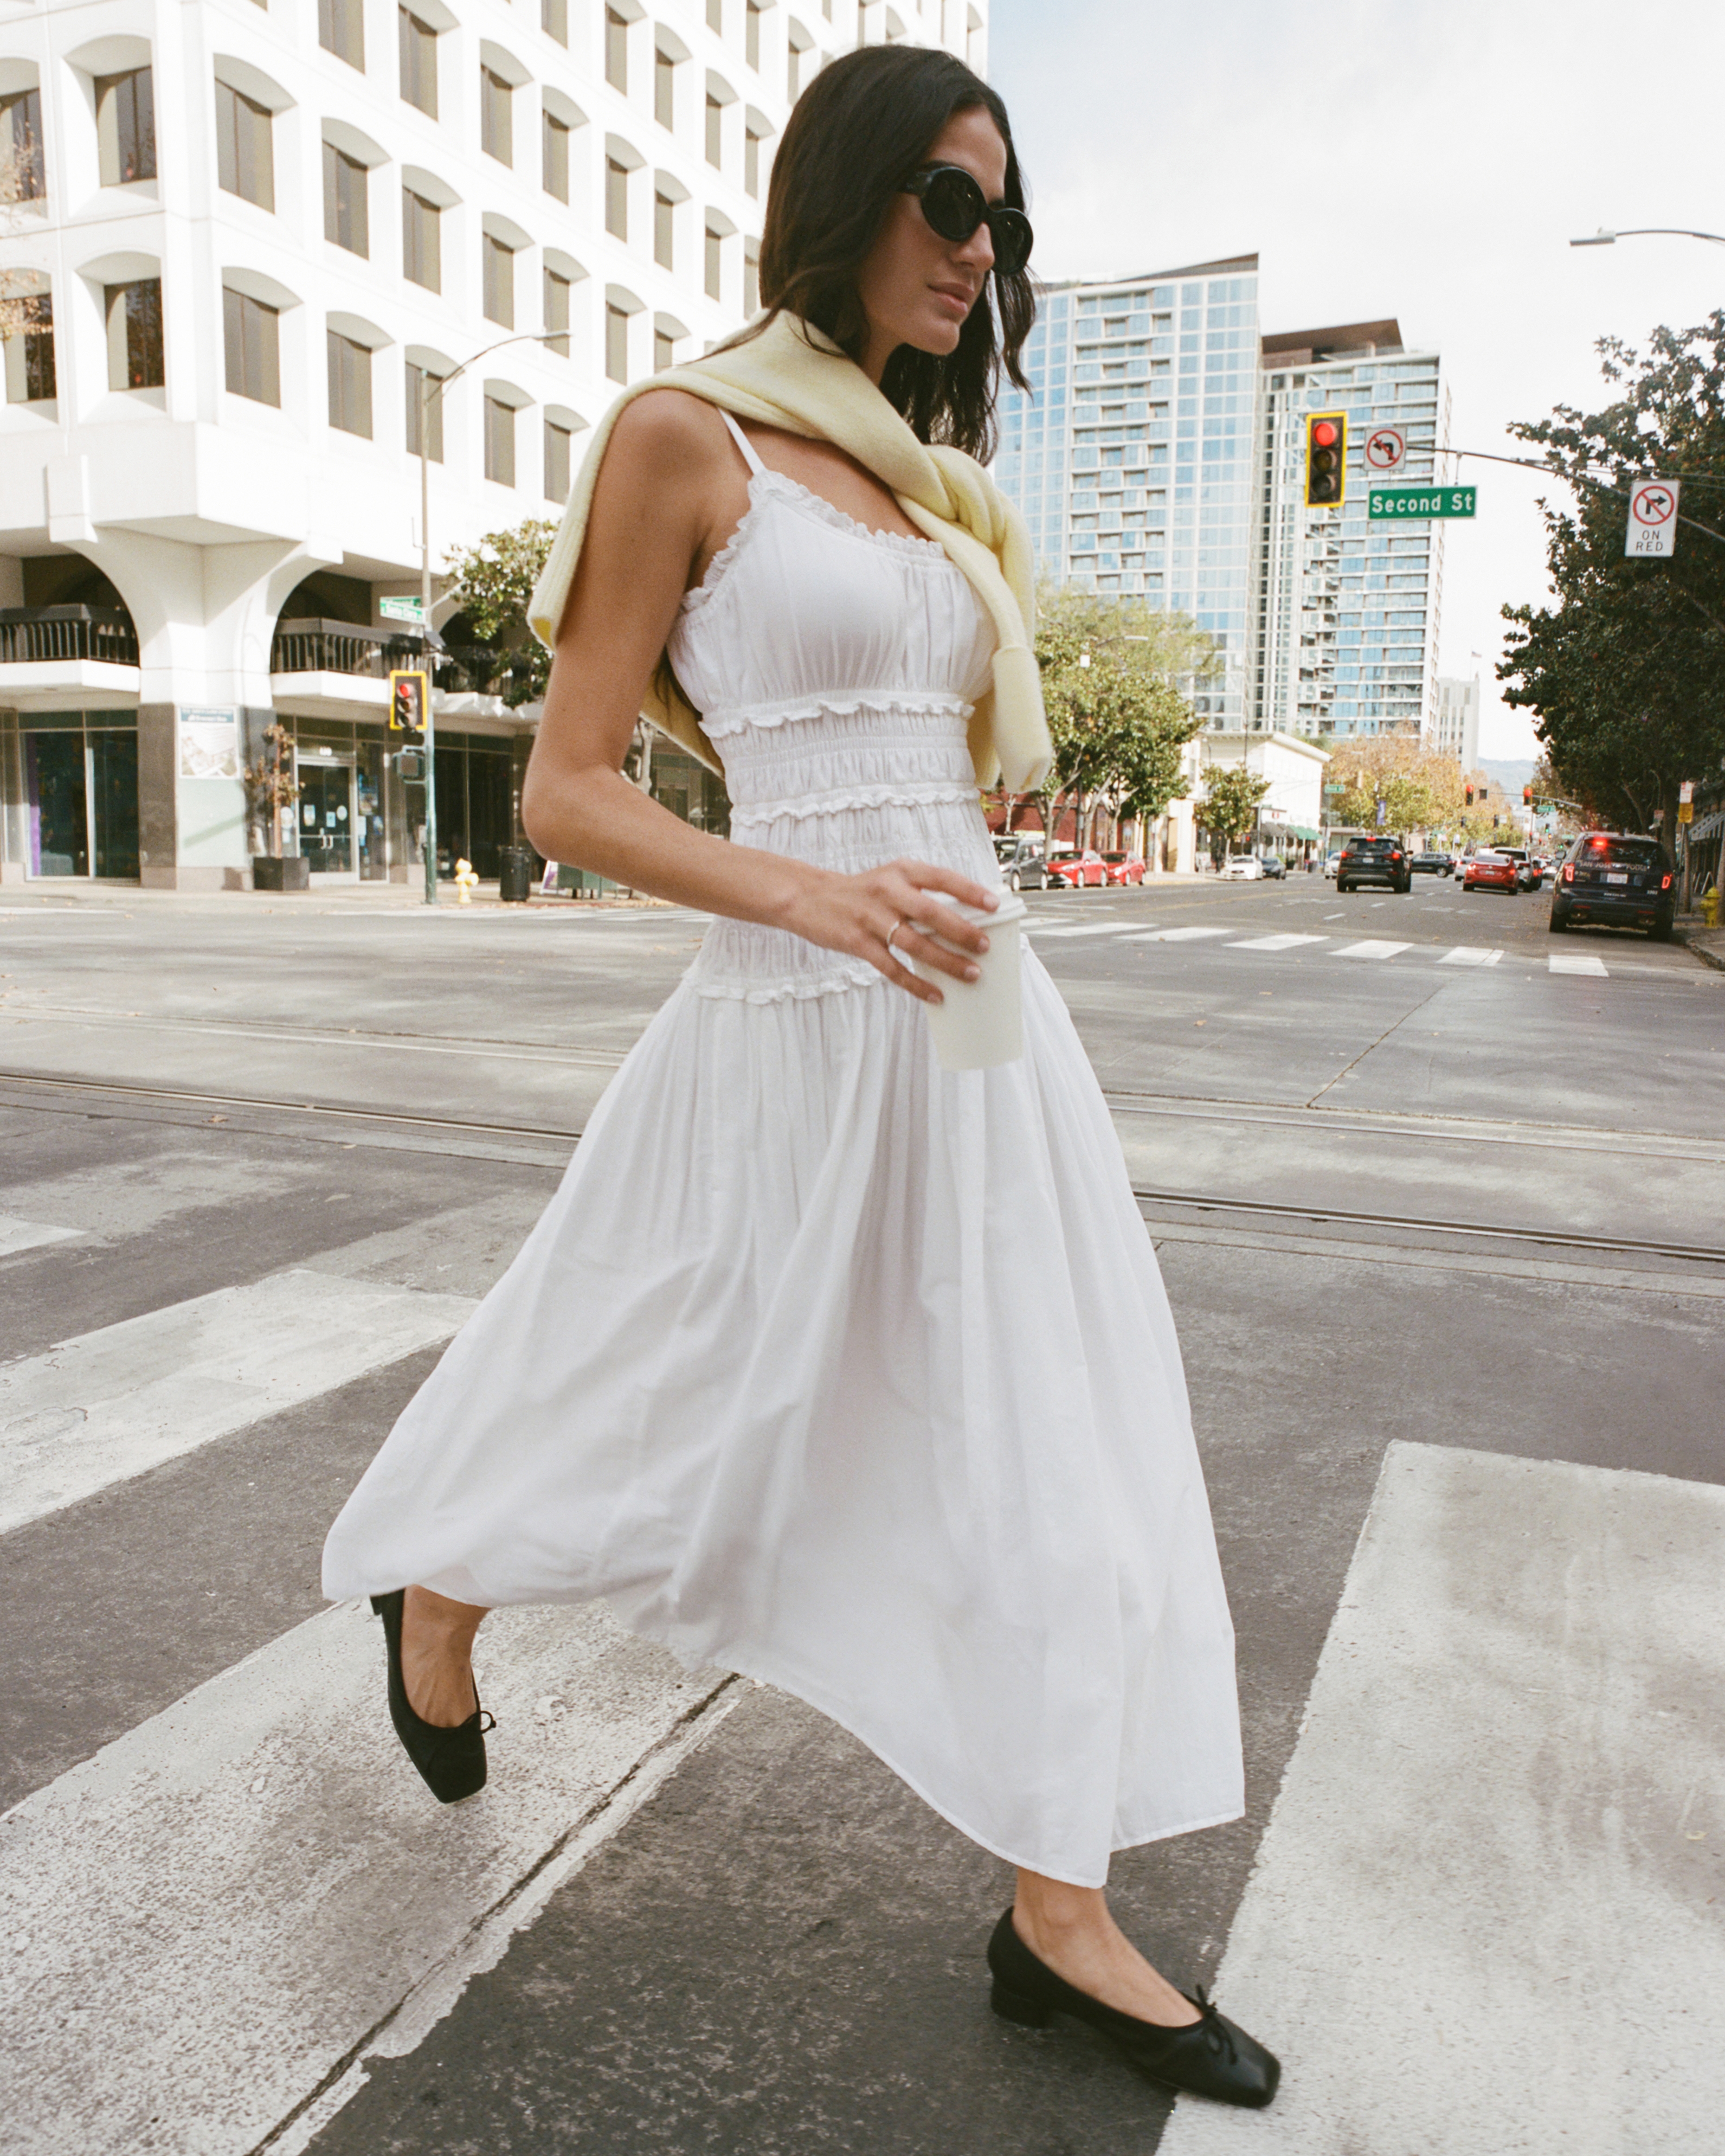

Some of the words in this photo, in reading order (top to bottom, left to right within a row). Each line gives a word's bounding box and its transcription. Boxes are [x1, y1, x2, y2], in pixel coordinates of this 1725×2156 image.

[1372, 494, 1441, 513] Second
[1451, 492, 1472, 511] St
[1642, 530, 1660, 540] ON
[1636, 542, 1663, 551] RED
